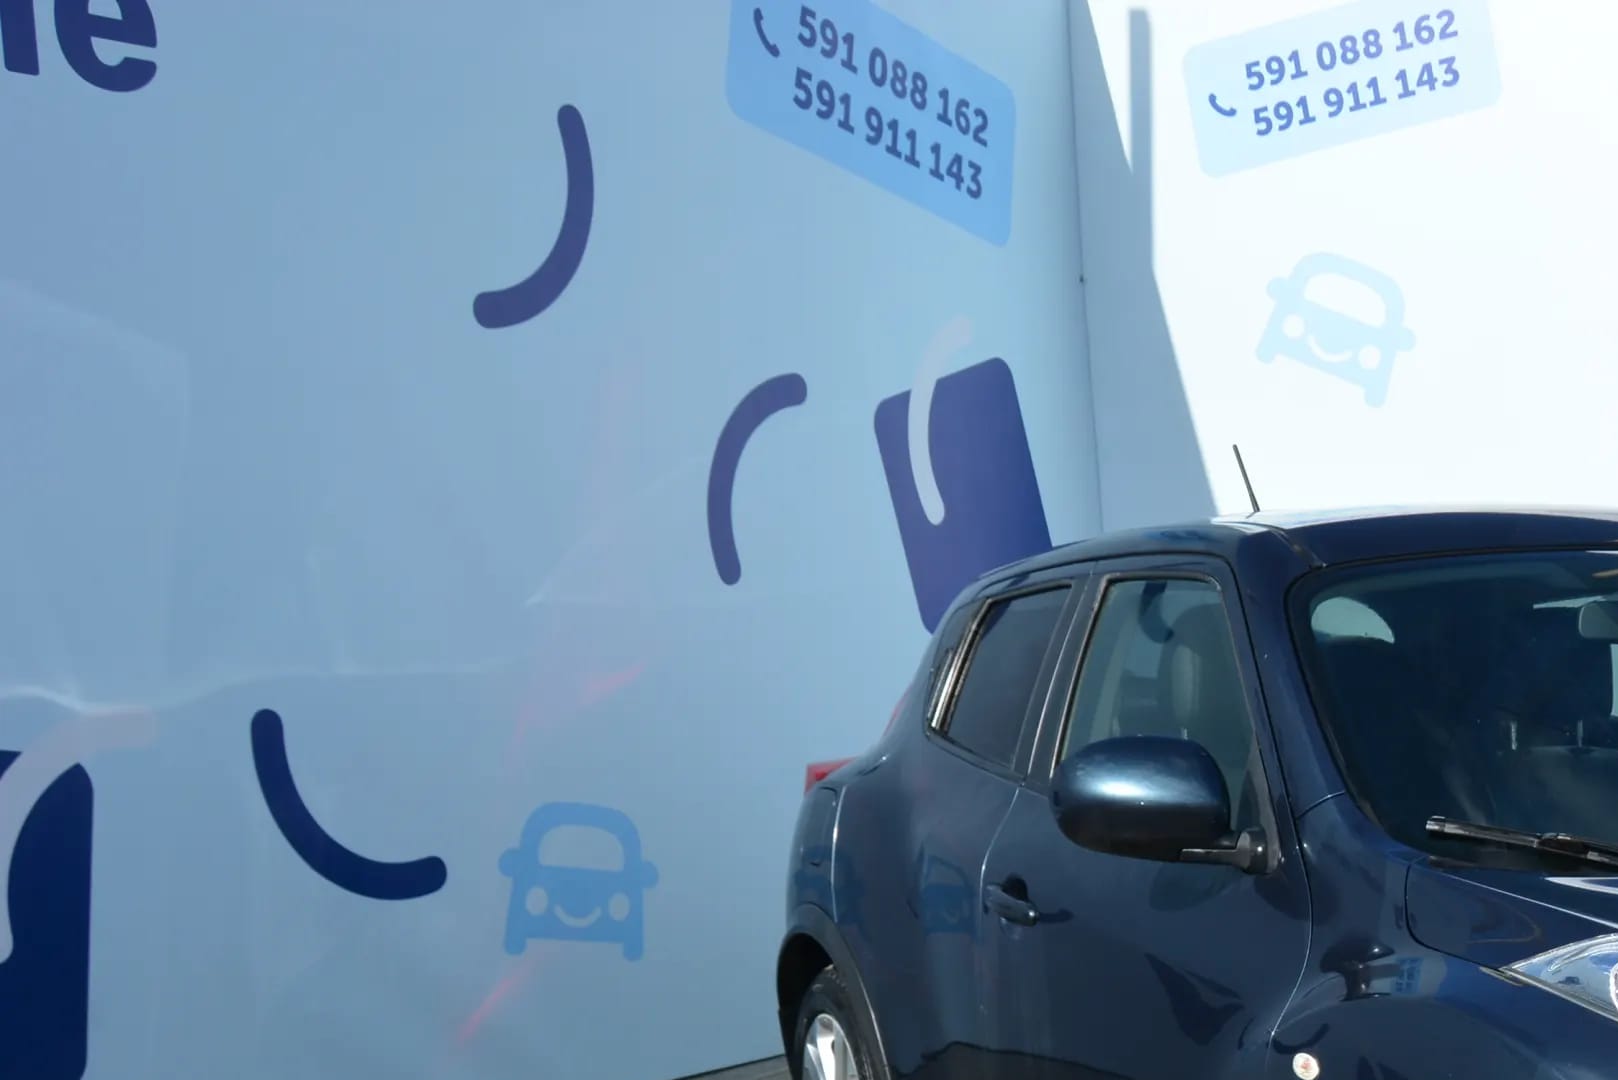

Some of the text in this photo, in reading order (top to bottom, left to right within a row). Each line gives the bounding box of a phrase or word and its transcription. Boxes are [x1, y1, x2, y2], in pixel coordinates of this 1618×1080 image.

[797, 4, 989, 148] 591 088 162
[1244, 9, 1459, 91] 591 088 162
[1252, 55, 1461, 137] 591 911 143
[792, 66, 983, 200] 591 911 143
